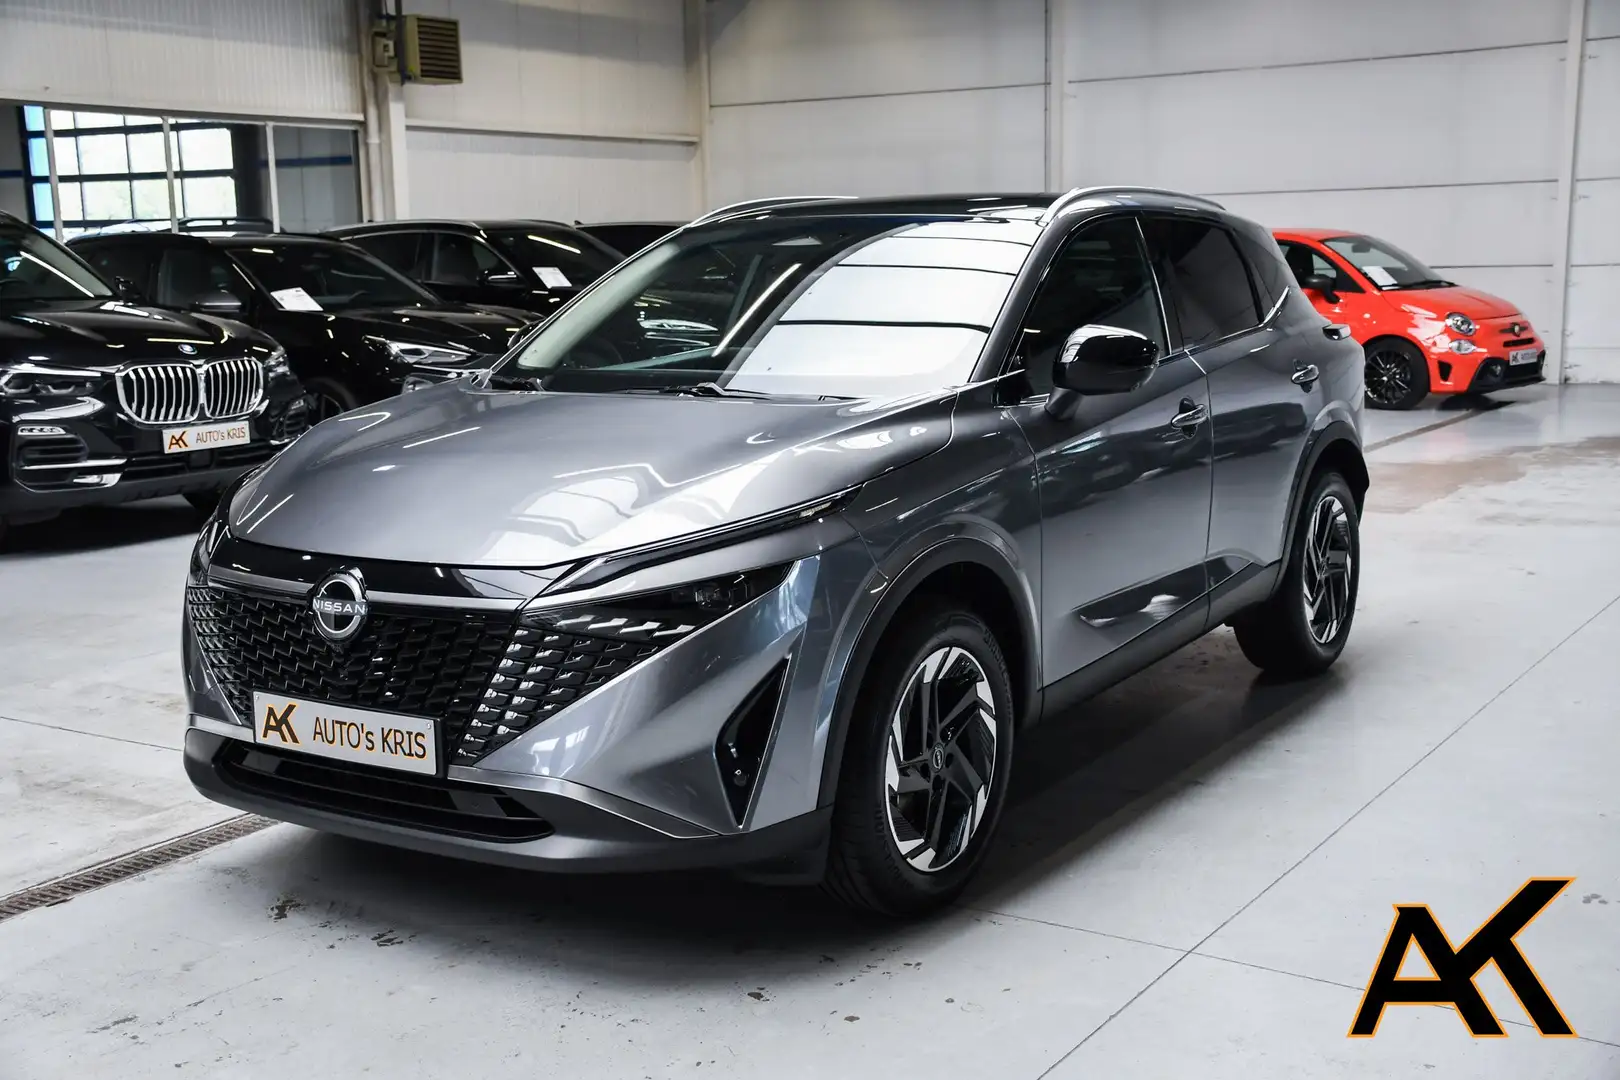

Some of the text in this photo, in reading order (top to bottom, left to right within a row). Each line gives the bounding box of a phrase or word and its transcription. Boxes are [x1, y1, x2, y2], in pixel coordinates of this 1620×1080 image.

[168, 427, 245, 450] AK AUTO's KRIS
[313, 598, 366, 615] NISSAN
[261, 703, 428, 760] AK AUTO's KRIS
